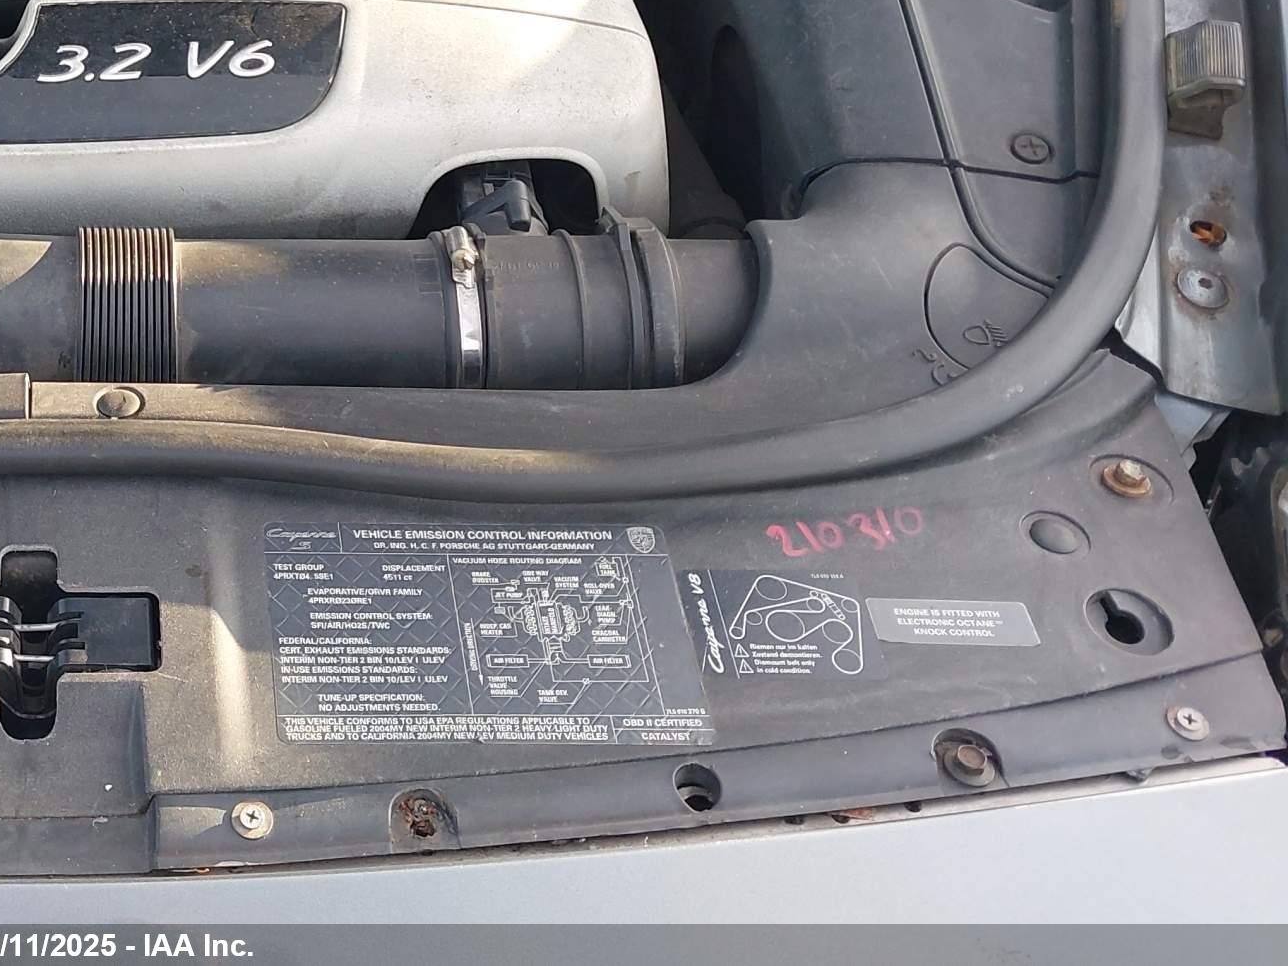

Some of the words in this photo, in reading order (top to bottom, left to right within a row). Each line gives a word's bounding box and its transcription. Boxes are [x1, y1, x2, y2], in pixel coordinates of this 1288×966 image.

[36, 42, 152, 83] 3.2
[187, 40, 275, 79] V6
[353, 530, 402, 540] VEHICLE
[405, 530, 464, 540] EMISSION
[468, 530, 527, 540] CONTROL
[530, 530, 613, 540] INFORMATION
[440, 542, 480, 550] PORSCHE
[483, 542, 495, 550] AG
[273, 563, 293, 571] TEST
[294, 563, 324, 571] GROUP
[688, 573, 705, 595] V8
[308, 588, 391, 596] EVAPORATIVE/ORVR
[393, 588, 423, 596] FAMILY
[310, 612, 352, 620] EMISSION
[353, 612, 394, 620] CONTROL
[396, 612, 433, 620] SYSTEM:
[893, 608, 928, 616] ENGINE
[974, 610, 1001, 618] WITH
[897, 618, 955, 626] ELECTRONIC
[697, 599, 725, 674] Cayenne
[949, 628, 995, 637] CONTROL
[279, 637, 372, 645] FEDERAL/CALIFORNIA:
[281, 656, 316, 664] INTERIM
[317, 656, 359, 664] NON-TIER
[360, 656, 365, 664] 2
[367, 656, 382, 664] BIN
[385, 656, 414, 664] 10/LEV
[415, 656, 419, 664] I
[422, 656, 445, 664] ULEV
[281, 666, 310, 674] IN-USE
[312, 666, 361, 674] EMISSIONS
[362, 666, 418, 674] STANDARDS:
[282, 675, 317, 683] INTERIM
[319, 675, 360, 683] NON-TIER
[362, 675, 368, 683] 2
[369, 675, 384, 683] BIN
[386, 675, 416, 683] 10/LEV
[418, 675, 421, 683] I
[425, 675, 448, 683] ULEV
[623, 718, 643, 727] OBD
[654, 718, 703, 727] CERTIFIED
